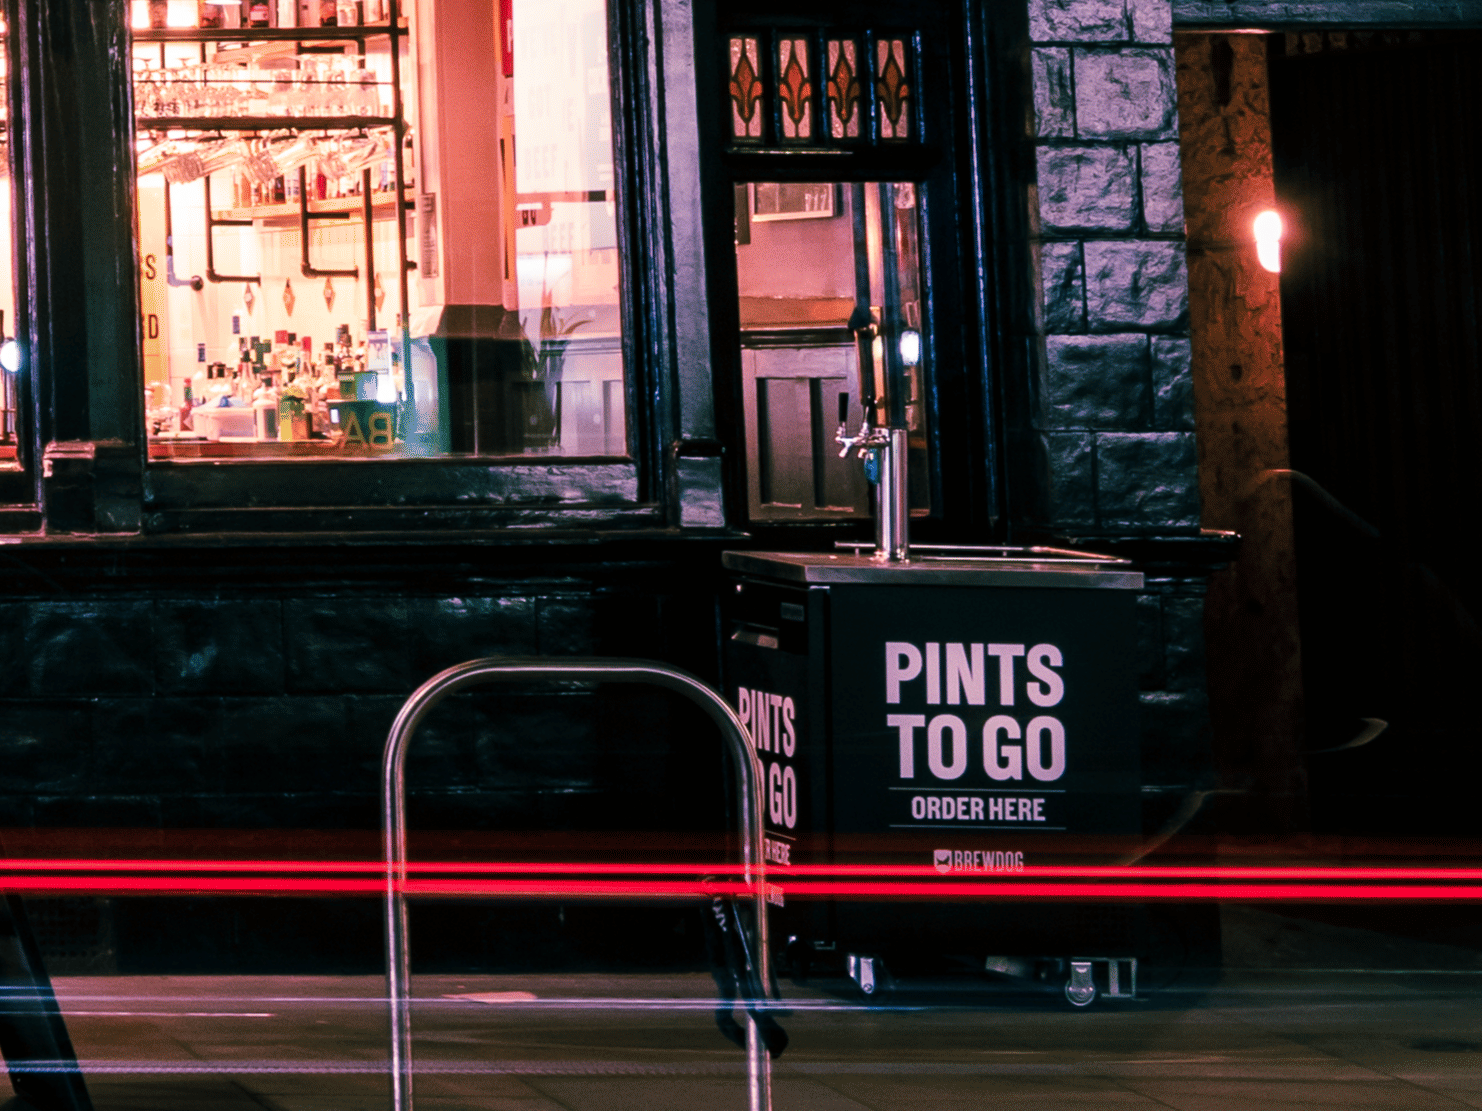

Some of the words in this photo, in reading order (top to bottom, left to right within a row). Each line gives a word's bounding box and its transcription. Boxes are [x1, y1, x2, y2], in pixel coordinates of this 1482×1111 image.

[885, 641, 1065, 708] PINTS
[738, 686, 796, 758] PINTS
[887, 713, 968, 780] TO
[982, 714, 1066, 782] GO
[768, 761, 797, 830] GO
[911, 795, 985, 821] ORDER
[988, 797, 1046, 822] HERE
[954, 850, 1024, 872] BREWDOG
